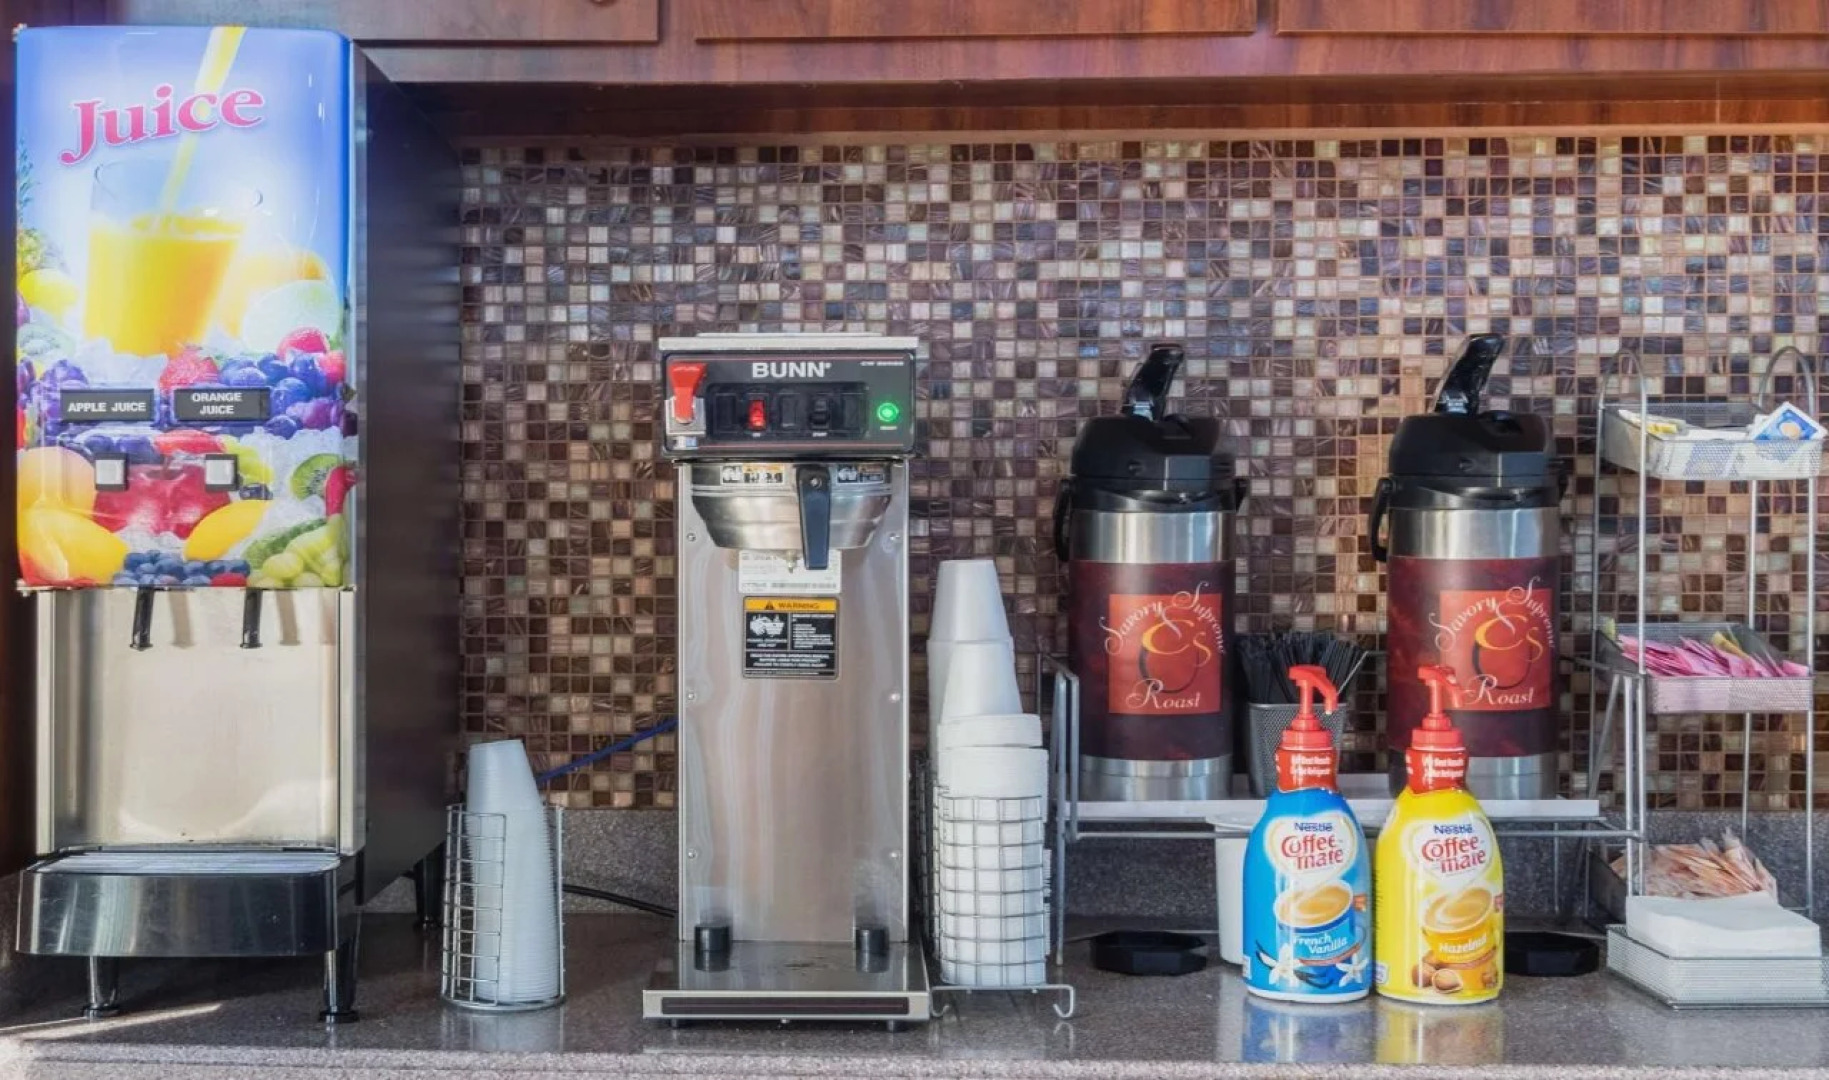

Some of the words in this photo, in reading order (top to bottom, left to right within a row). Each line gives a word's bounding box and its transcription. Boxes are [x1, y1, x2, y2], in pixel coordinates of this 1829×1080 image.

[60, 83, 265, 165] Juice
[752, 362, 826, 378] BUNN
[191, 392, 243, 402] ORANGE
[68, 402, 107, 413] APPLE
[111, 402, 147, 413] JUICE
[199, 404, 235, 415] JUICE
[1428, 597, 1497, 651] Savory
[1126, 679, 1201, 709] Roast
[1464, 674, 1534, 705] Roast
[1296, 849, 1344, 870] mate
[1441, 850, 1486, 873] mate
[1292, 931, 1332, 945] French
[1308, 936, 1348, 954] Vanilla
